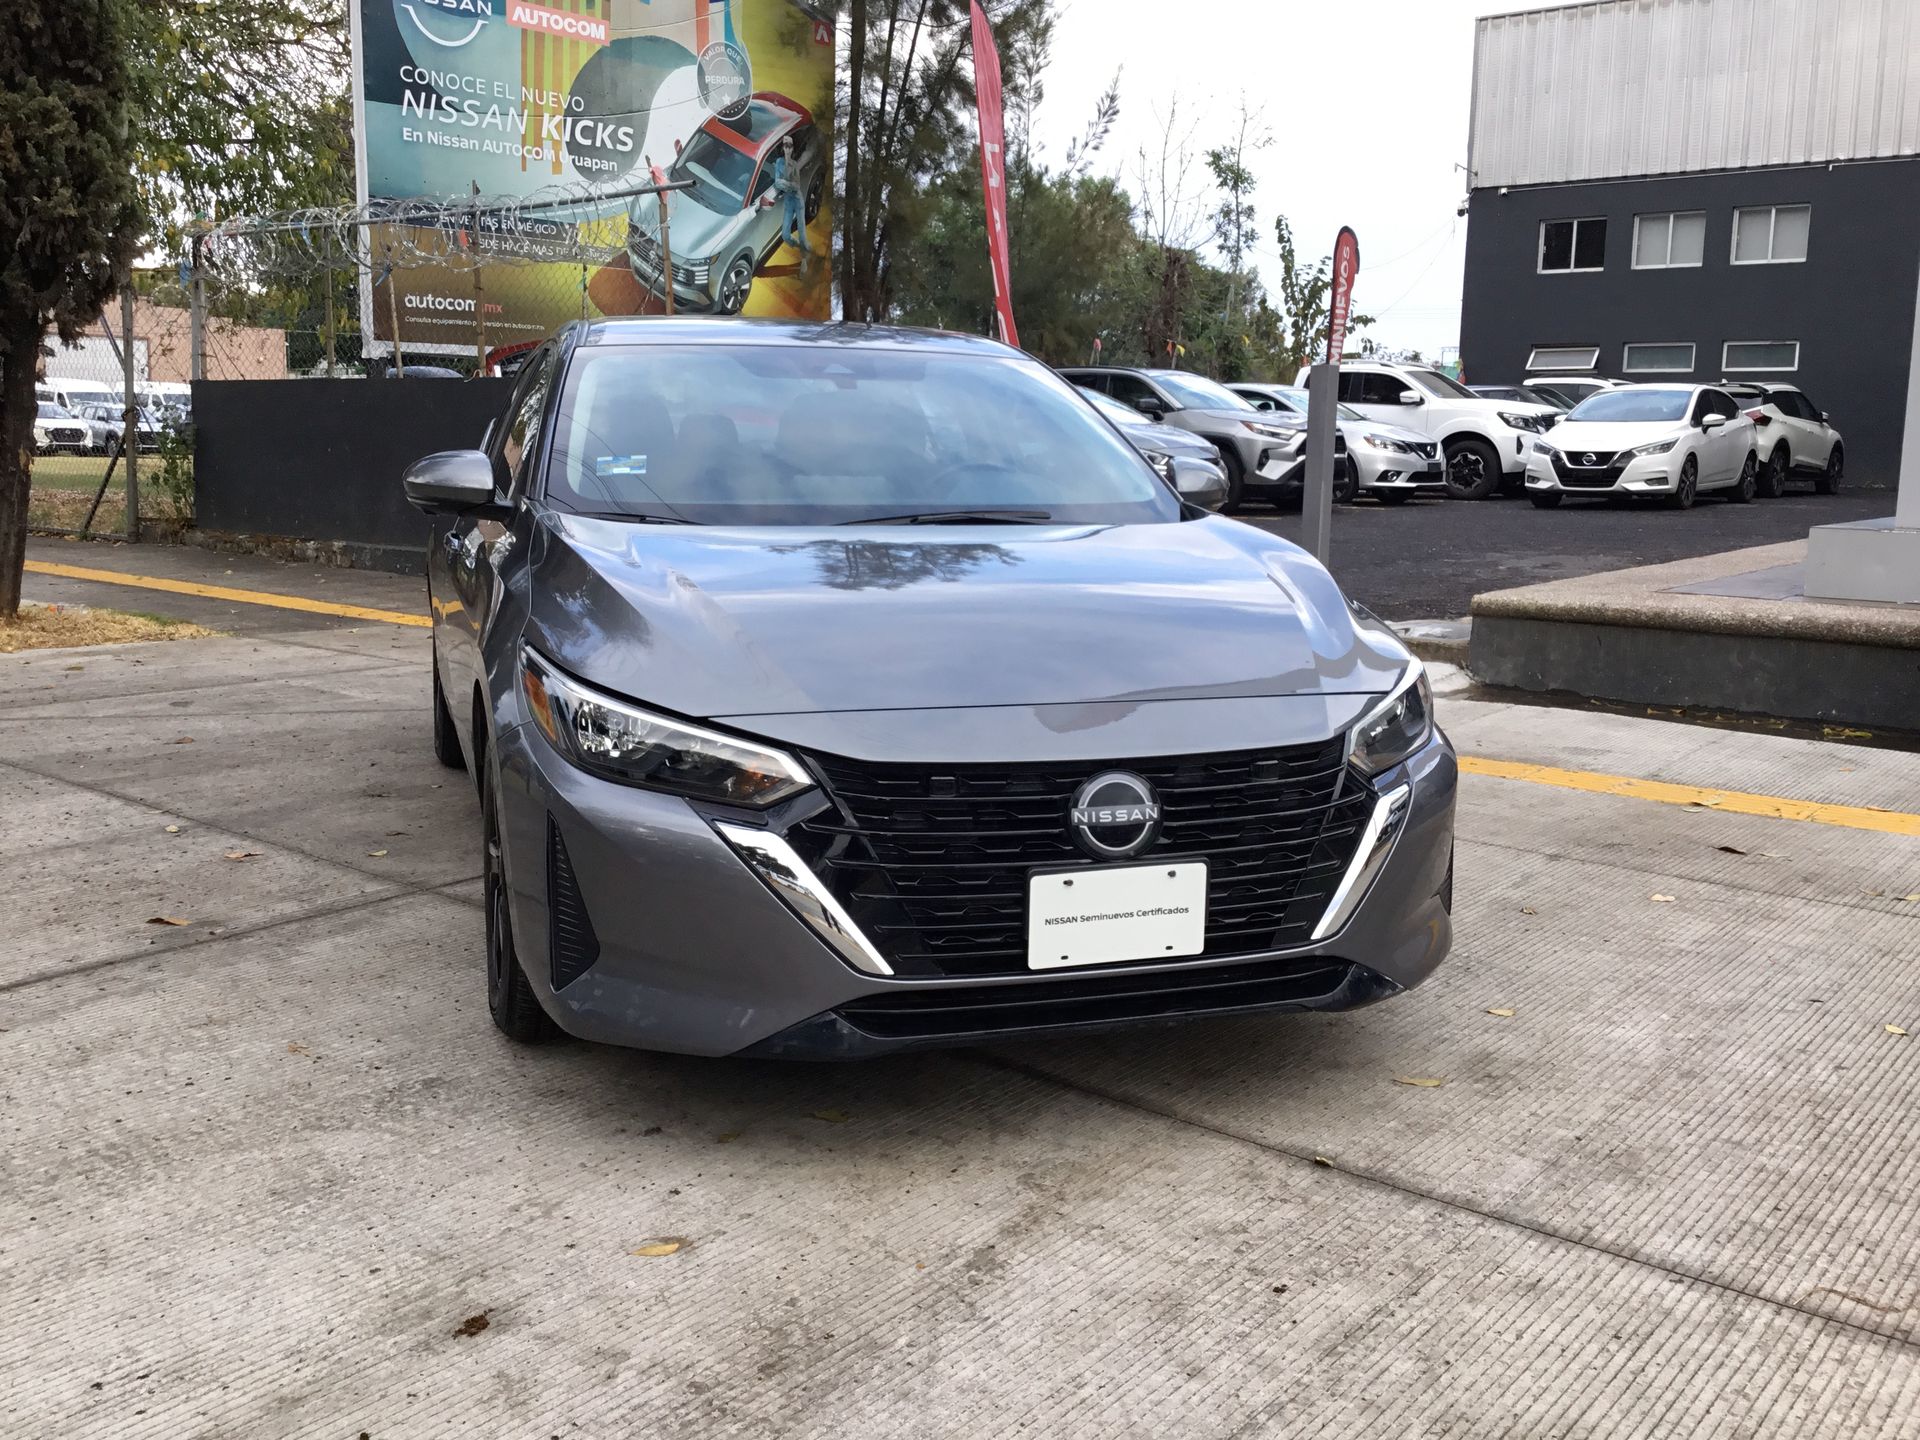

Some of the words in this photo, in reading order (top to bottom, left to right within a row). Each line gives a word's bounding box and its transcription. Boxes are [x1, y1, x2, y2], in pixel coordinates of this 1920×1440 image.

[512, 6, 605, 40] AUTOCOM
[704, 45, 725, 61] VALOR
[400, 65, 486, 95] CONOCE
[493, 83, 515, 100] EL
[521, 86, 585, 113] NUEVO
[705, 75, 746, 86] PERDURA
[401, 89, 528, 136] NISSAN
[541, 112, 634, 152] KICKS
[402, 127, 423, 143] En
[427, 131, 479, 151] Nissan
[482, 138, 556, 163] AUTOCOM
[517, 219, 557, 235] MÉXICO
[1073, 806, 1159, 824] NISSAN
[1044, 915, 1078, 926] NISSAN
[1079, 911, 1135, 923] Seminuevos
[1136, 906, 1190, 918] Certificados
